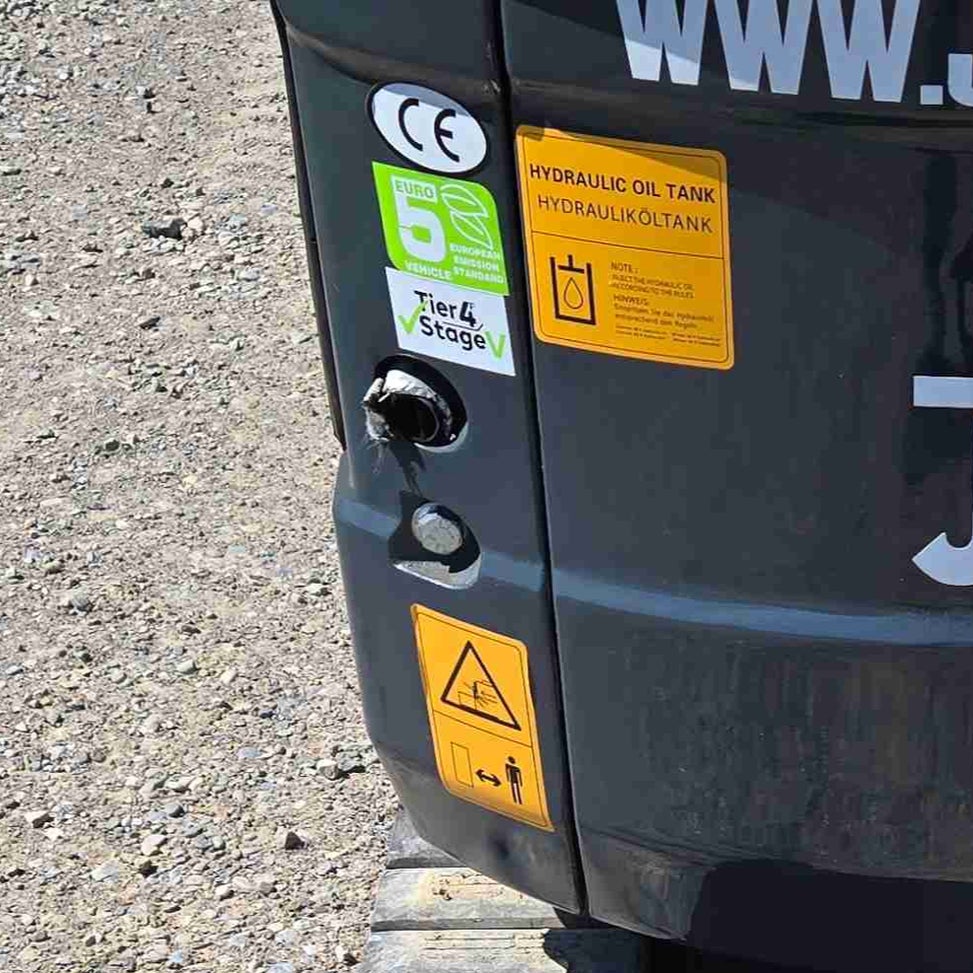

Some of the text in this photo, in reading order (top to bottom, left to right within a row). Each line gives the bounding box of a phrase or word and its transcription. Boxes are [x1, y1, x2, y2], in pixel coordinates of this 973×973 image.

[395, 180, 434, 199] EURO
[529, 163, 716, 203] HYDRAULIC OIL TANK
[538, 194, 713, 233] HYDRAULIKÖLTANK
[450, 243, 501, 258] EUROPEAN
[405, 260, 452, 280] VEHICLE
[419, 315, 486, 351] Stage
